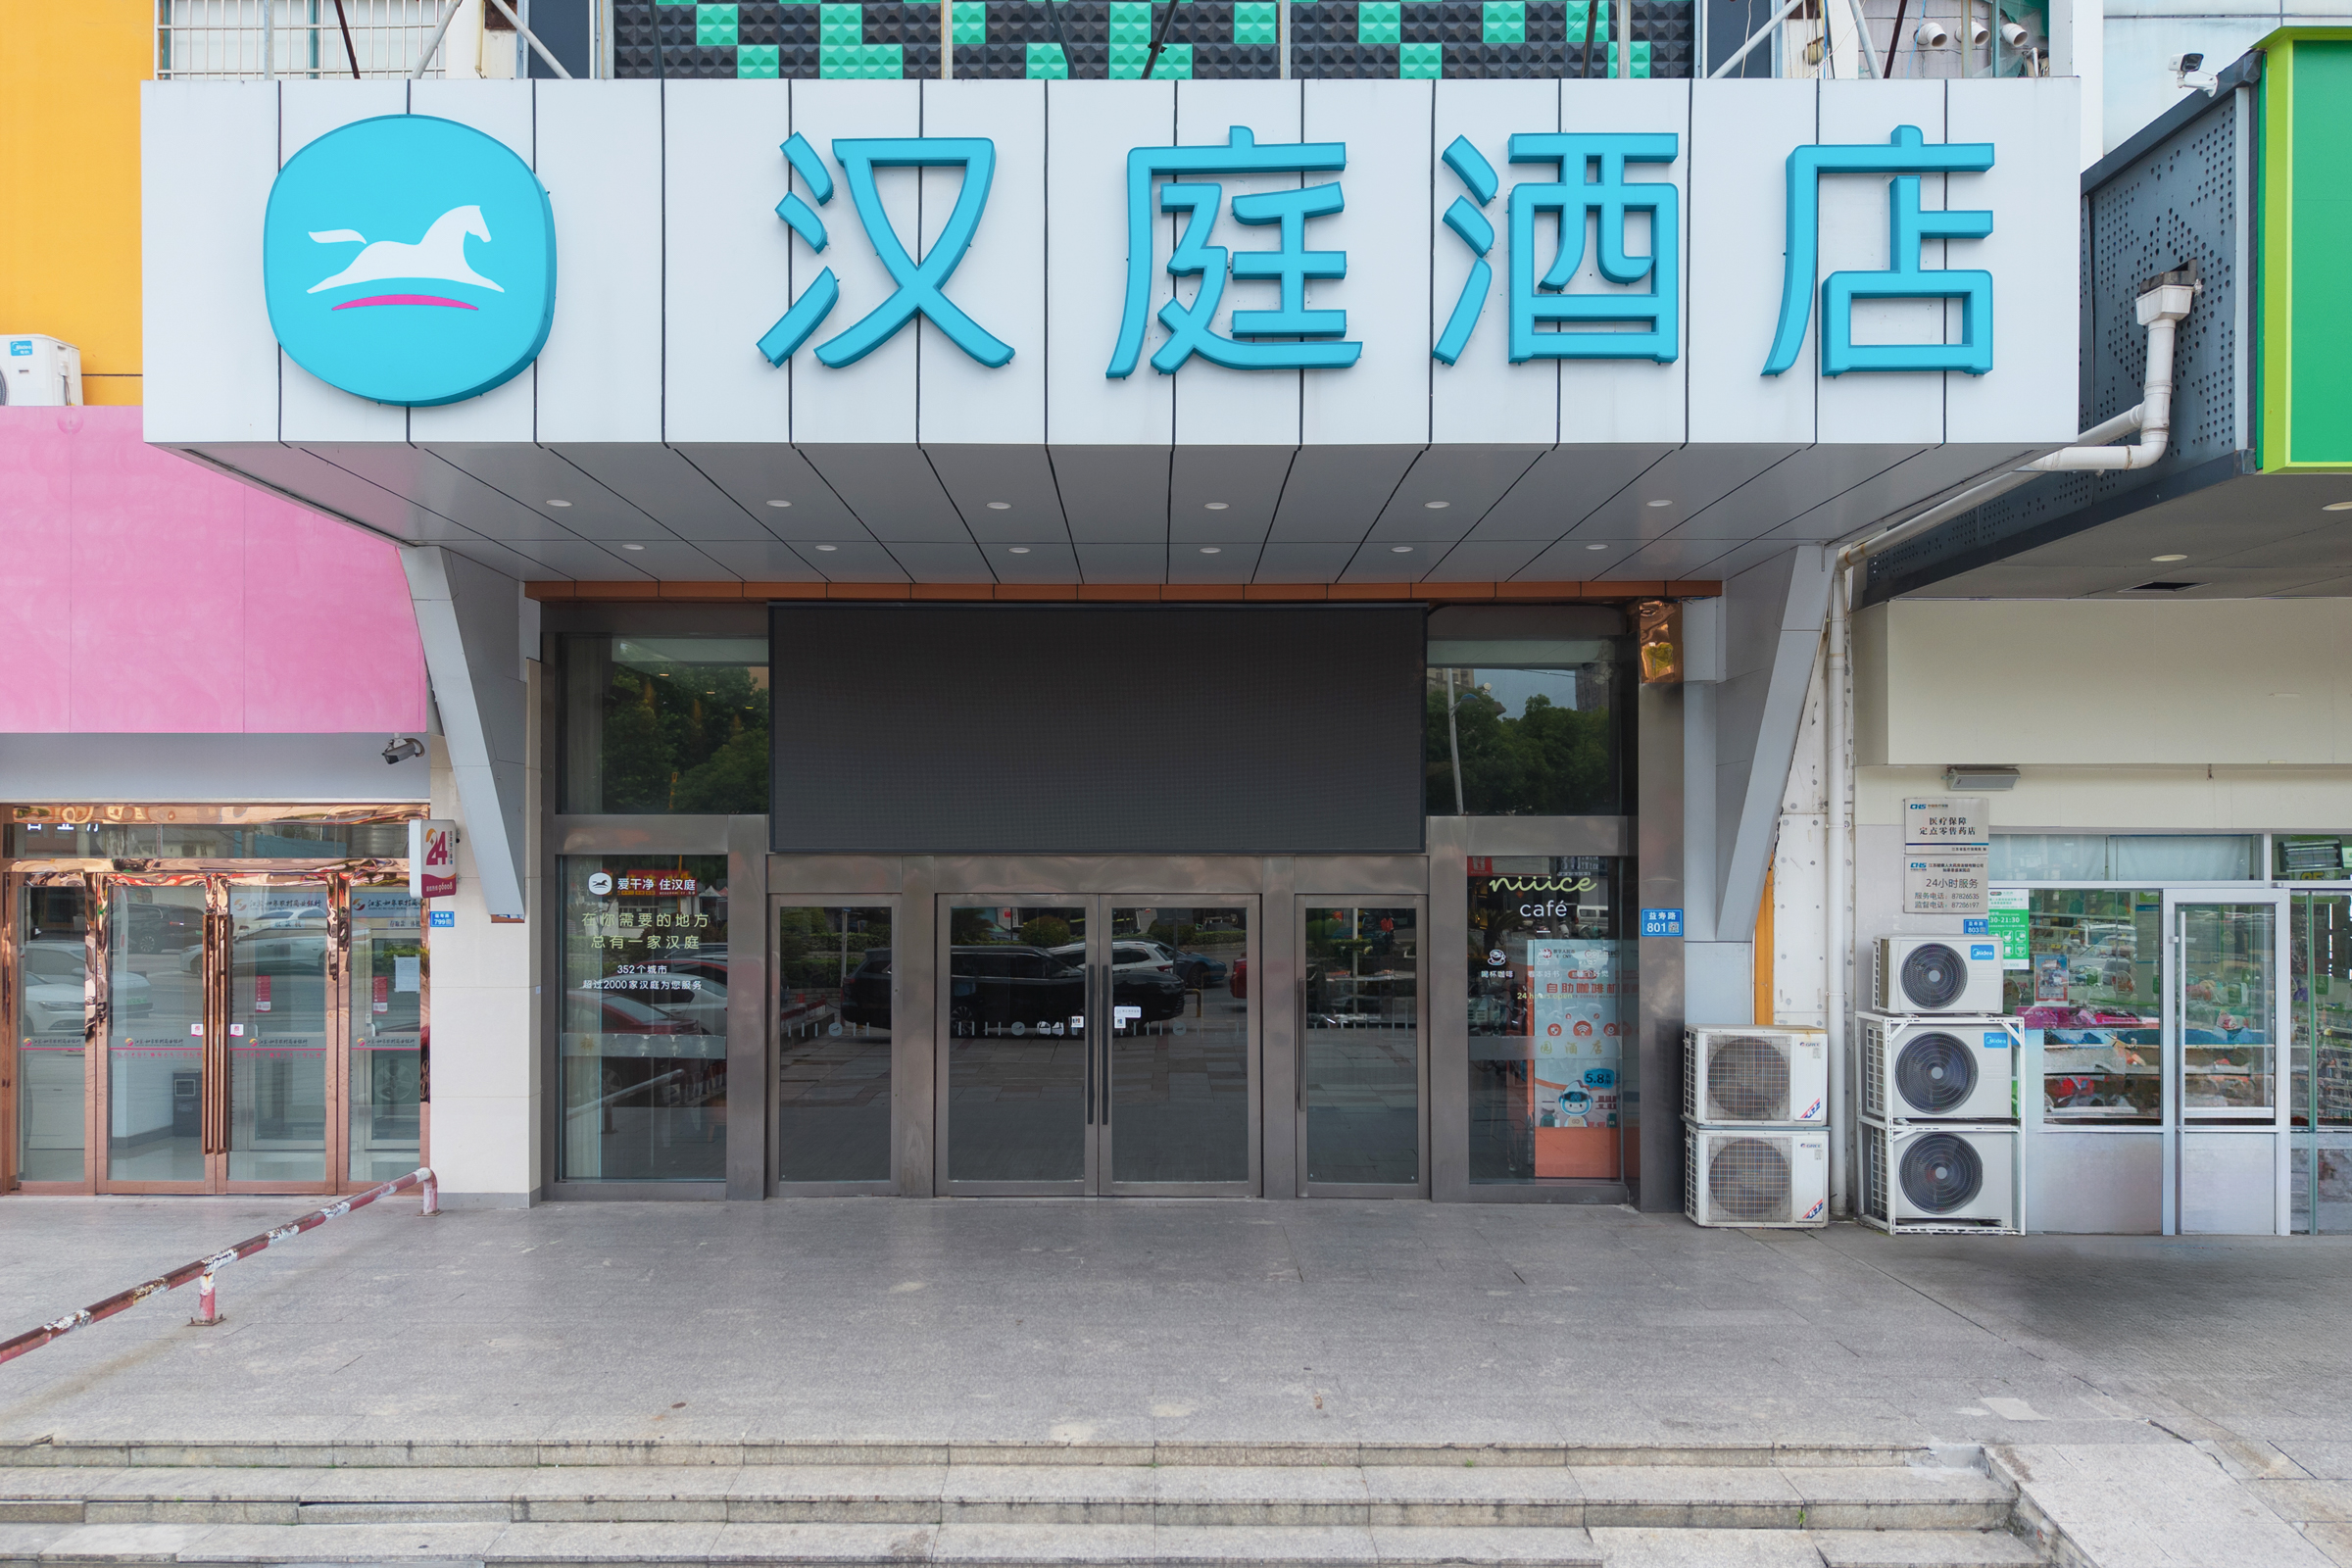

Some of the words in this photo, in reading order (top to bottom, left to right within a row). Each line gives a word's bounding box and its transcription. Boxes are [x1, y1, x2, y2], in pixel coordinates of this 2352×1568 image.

[756, 123, 1994, 379] 汉庭酒店
[1919, 826, 1976, 836] 定点零售药店
[425, 828, 448, 865] 24
[617, 877, 655, 890] 爱干净
[659, 878, 696, 891] 住汉庭
[1489, 875, 1597, 892] niiice
[1926, 878, 1979, 889] 24小时服务
[1519, 900, 1568, 917] café
[581, 912, 710, 928] 在你需要的地方
[1646, 922, 1666, 933] 801
[590, 935, 700, 950] 总有一家汉庭
[616, 964, 667, 975] 352个城市
[582, 979, 703, 991] 超过2000家汉庭为您服务
[1585, 1073, 1605, 1084] 5.8
